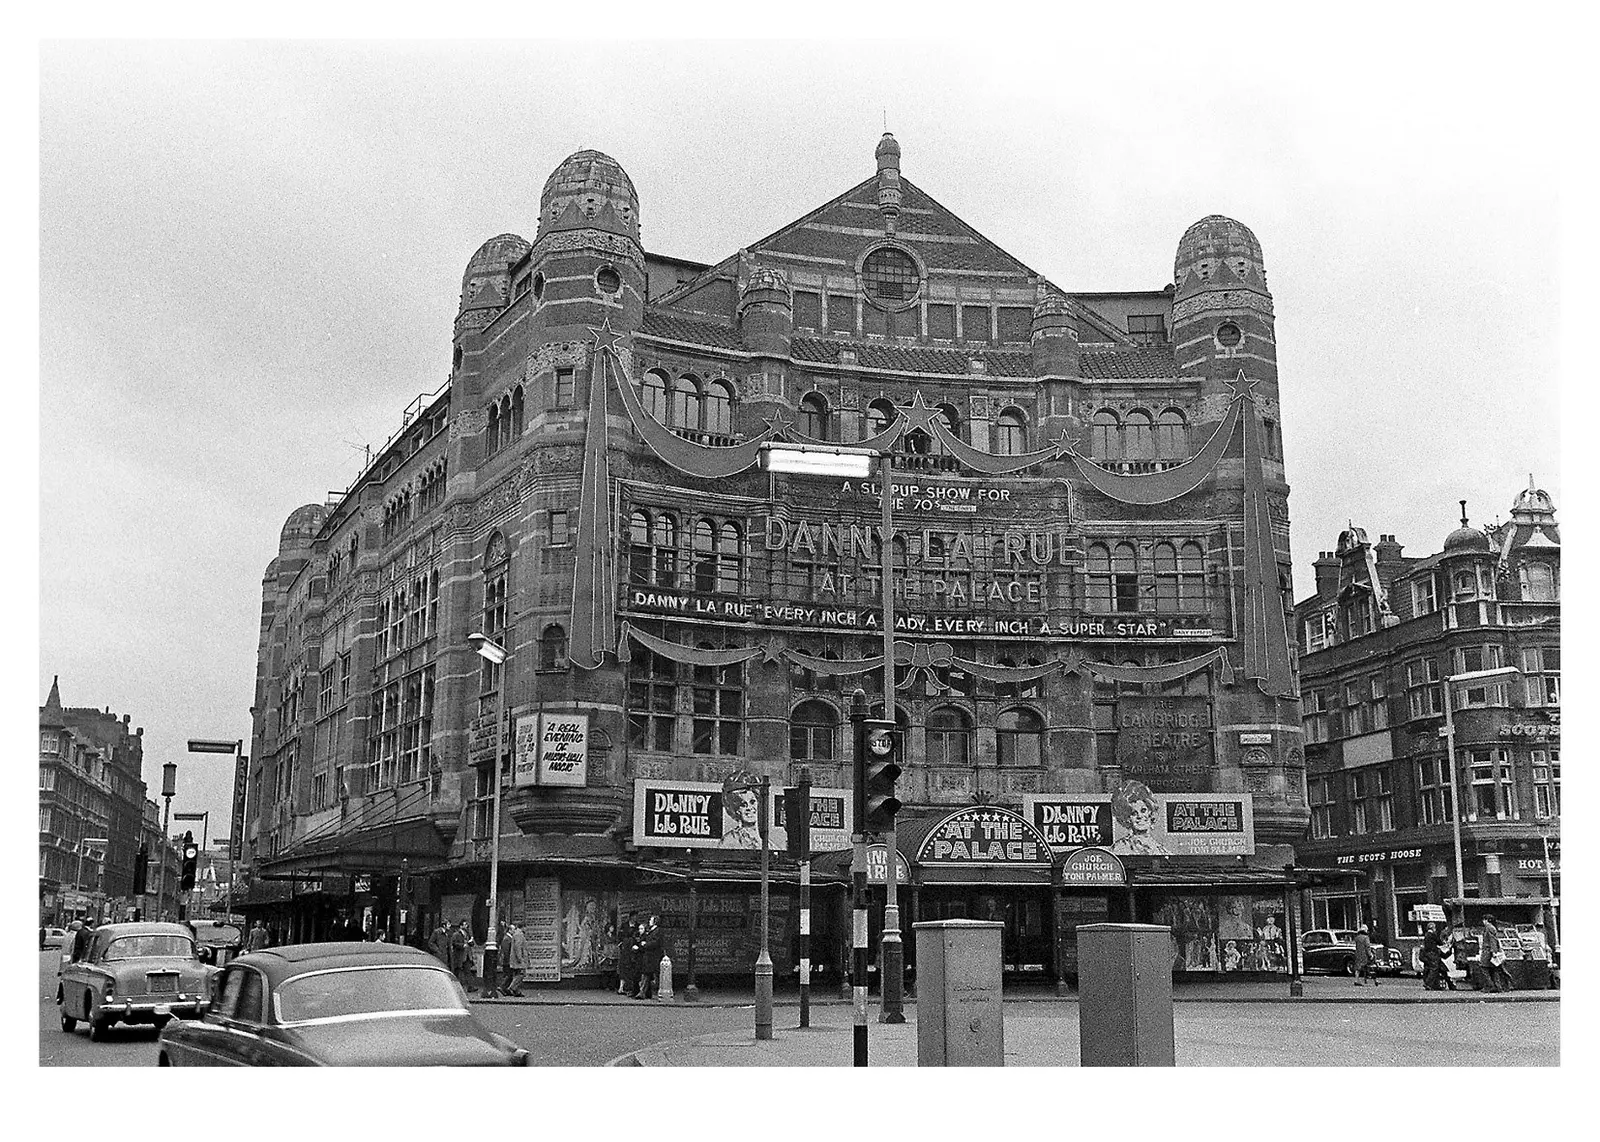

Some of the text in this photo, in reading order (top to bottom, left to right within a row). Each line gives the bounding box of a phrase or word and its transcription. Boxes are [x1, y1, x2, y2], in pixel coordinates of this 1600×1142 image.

[842, 481, 852, 493] A
[926, 486, 971, 500] SHOW
[978, 489, 1010, 502] FOR
[923, 529, 974, 564] LA
[1003, 531, 1080, 566] RUE
[821, 573, 851, 596] AT
[934, 580, 1041, 603] PALACE
[634, 592, 1167, 636] DANNY LA RUE "EVERY INCH A ADY. EVERY INCH A SUPER STAR"
[558, 723, 580, 733] REAL
[1122, 712, 1208, 728] CAMBRIDGE
[544, 733, 584, 743] EVENING
[1130, 732, 1201, 748] THEATRE
[556, 742, 569, 752] OF
[654, 792, 711, 814] DANNY
[1174, 803, 1236, 817] AT THE
[1042, 805, 1100, 824] DANNY
[653, 814, 711, 836] LA RUE
[944, 821, 1023, 840] AT THE
[1172, 817, 1238, 831] PALACE
[1043, 825, 1102, 843] LA RUE
[934, 840, 1038, 861] PALACE
[1208, 838, 1247, 847] CHURCH
[1084, 854, 1103, 863] JOE
[1337, 849, 1422, 864] THE SCOTS HOOSE
[1518, 859, 1543, 869] HOT
[1071, 862, 1113, 871] CHURCH
[1064, 872, 1121, 881] TONI PALMER
